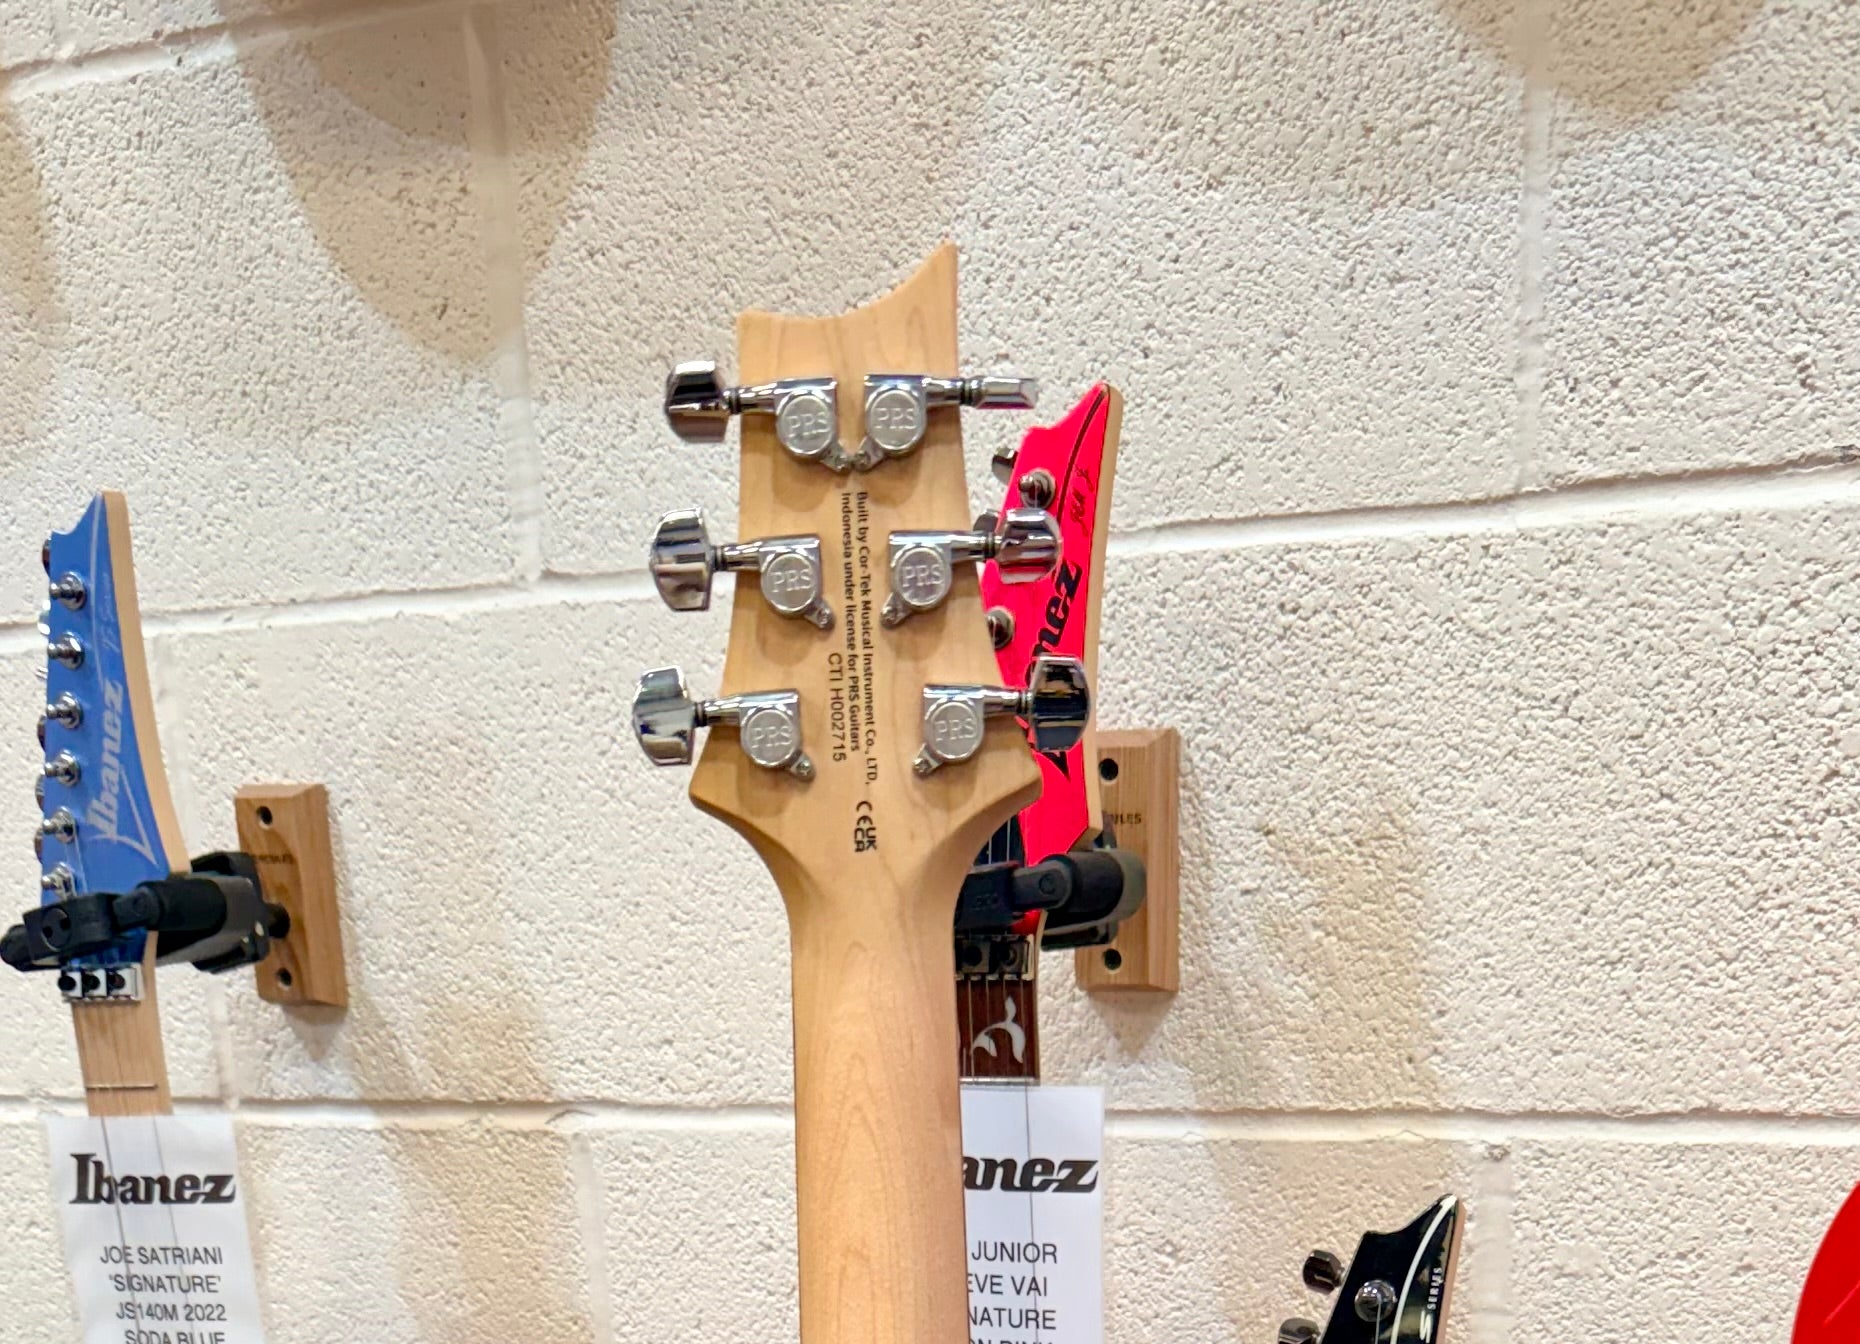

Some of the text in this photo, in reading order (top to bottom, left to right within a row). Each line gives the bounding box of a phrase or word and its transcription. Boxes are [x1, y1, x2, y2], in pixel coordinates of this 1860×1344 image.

[786, 410, 831, 438] PRS
[874, 407, 917, 430] PRS
[857, 491, 868, 522] Built
[856, 527, 869, 541] by
[769, 569, 812, 593] PRS
[859, 546, 872, 596] Cor-Tek
[901, 563, 945, 588] PRS
[842, 492, 861, 751] Indonesia under license for PRS Guitars
[861, 600, 873, 649] Musical
[863, 653, 875, 726] Instrument
[751, 725, 793, 749] PRS
[829, 687, 847, 762] H002715
[934, 717, 976, 742] PRS
[85, 677, 124, 844] Ibanez
[69, 1153, 236, 1205] Ibanez
[962, 1156, 1099, 1193] anez
[100, 1246, 223, 1265] JOE SATRIANI
[971, 1241, 1058, 1264] JUNIOR
[967, 1273, 1048, 1297] EVE VAI
[1427, 1267, 1443, 1310] SERIES
[116, 1302, 228, 1322] JS140M 2022
[967, 1306, 1057, 1330] NATURE
